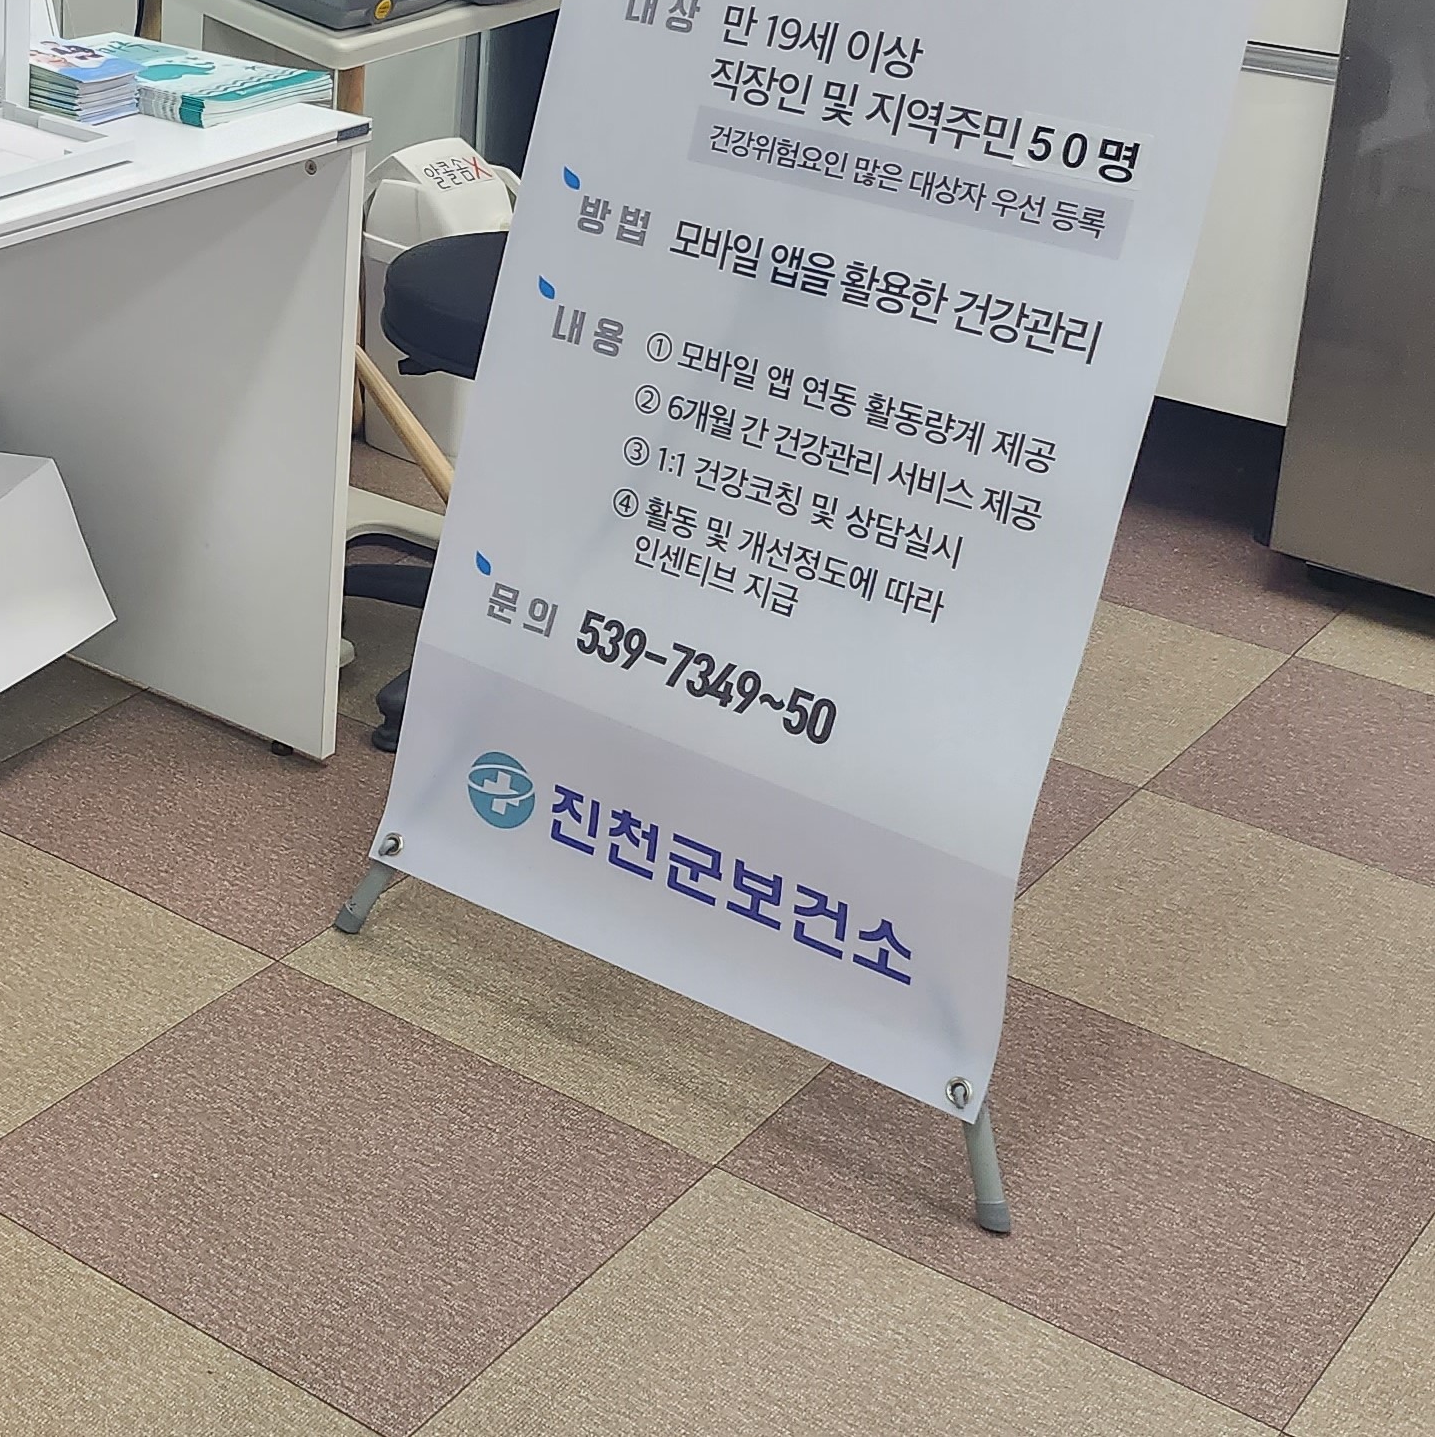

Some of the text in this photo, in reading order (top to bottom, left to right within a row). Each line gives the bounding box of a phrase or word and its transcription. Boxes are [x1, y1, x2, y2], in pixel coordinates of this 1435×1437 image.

[722, 5, 759, 47] 만
[766, 14, 840, 66] 19세
[847, 26, 925, 80] 이상
[709, 57, 813, 117] 직장인
[821, 79, 859, 128] 및
[865, 89, 1023, 162] 지역주민
[708, 123, 1107, 241] 건강위험요인 많은 대상자 우선 등록
[576, 195, 1104, 366] 방법 모바일 앱을 활용한 건강관리
[551, 304, 625, 359] 내용
[676, 340, 759, 391] 모바일
[767, 364, 795, 401] 앱
[801, 374, 858, 419] 연동
[863, 392, 986, 456] 활동량계
[990, 425, 1058, 475] 제공
[657, 446, 687, 479] 1:1
[693, 455, 805, 518] 건강코칭
[810, 491, 840, 530] 및
[844, 502, 965, 571] 상담실시
[667, 394, 737, 442] 6개월
[739, 413, 770, 451] 간
[773, 423, 884, 486] 건강관리
[887, 459, 975, 512] 서비스
[979, 486, 1045, 533] 제공
[633, 534, 801, 619] 인센티브 지급
[644, 495, 699, 542] 활동
[706, 515, 734, 553] 및
[736, 525, 880, 603] 개선정도에
[883, 575, 946, 625] 따라
[486, 582, 839, 747] 문의 539-7349~50
[549, 784, 914, 987] 진천군보건소
